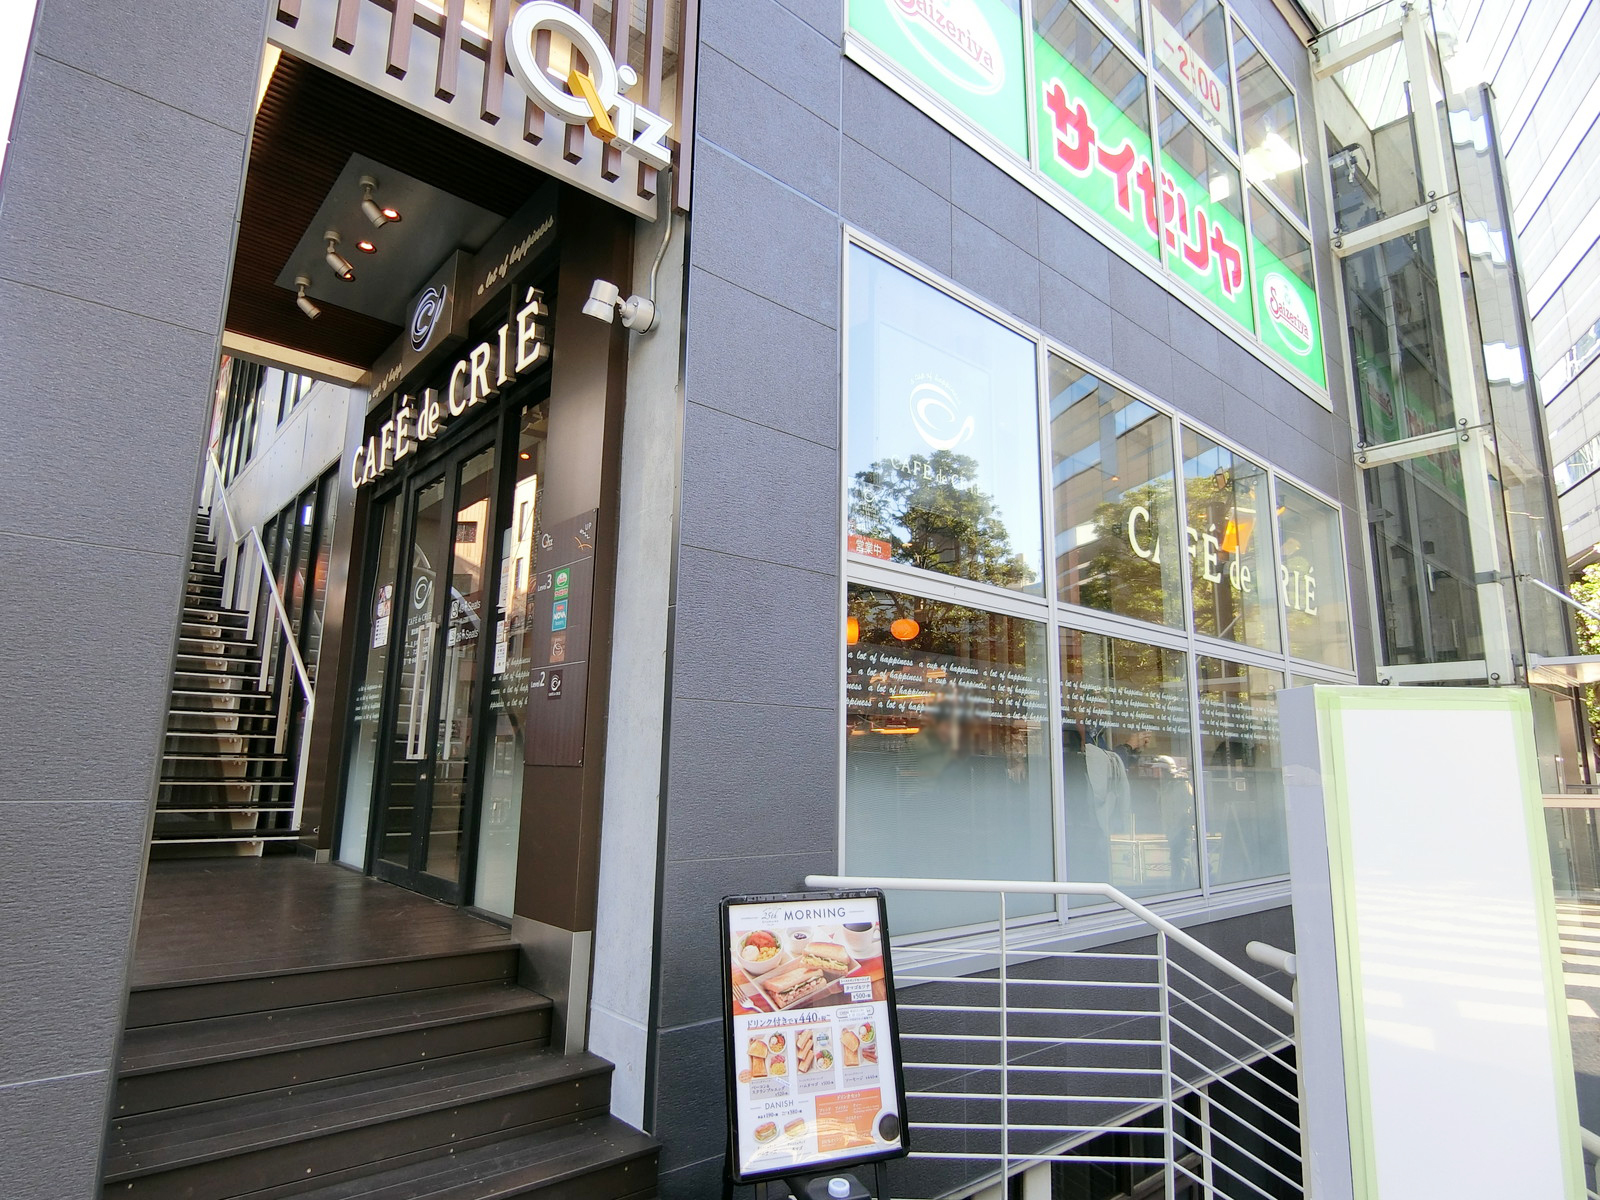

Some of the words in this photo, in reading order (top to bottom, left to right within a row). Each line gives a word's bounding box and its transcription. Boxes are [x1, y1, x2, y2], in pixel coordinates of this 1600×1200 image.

[1044, 79, 1244, 302] サイゼリヤ
[1269, 286, 1310, 338] Saizeriya
[352, 394, 413, 489] CAFÉ
[418, 388, 441, 441] de
[449, 286, 542, 417] CRIÉ
[856, 538, 882, 557] 営業中
[1229, 545, 1251, 593] de
[880, 653, 914, 667] happiness
[540, 671, 546, 687] 2
[784, 907, 846, 921] MORNING
[765, 1099, 794, 1110] DANISH
